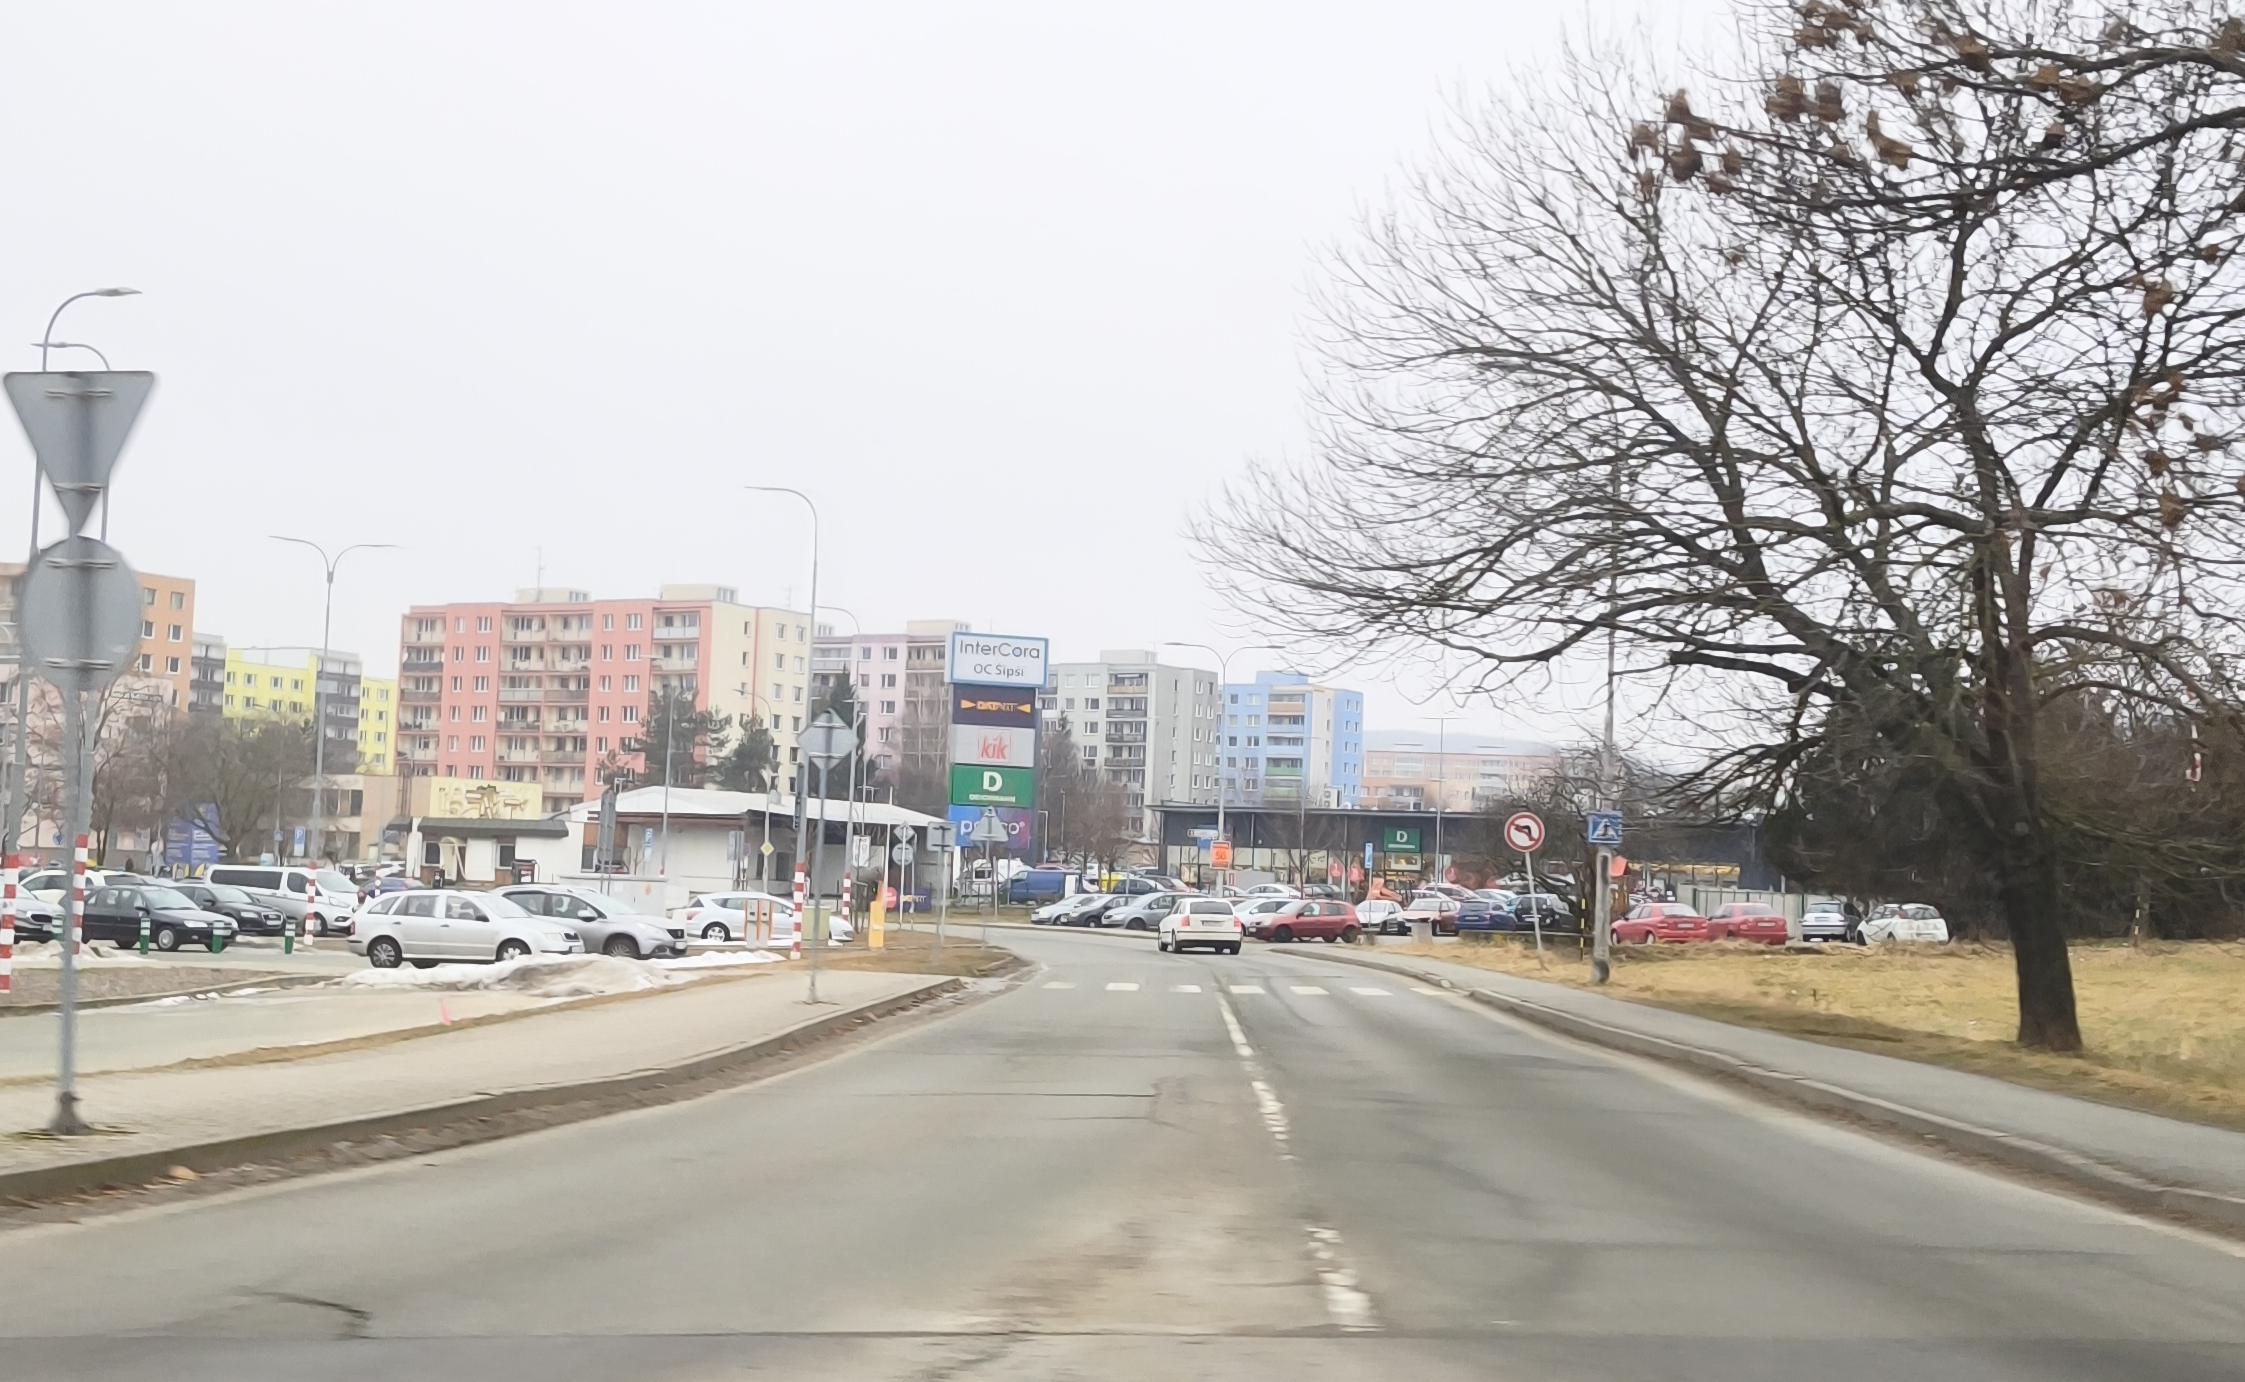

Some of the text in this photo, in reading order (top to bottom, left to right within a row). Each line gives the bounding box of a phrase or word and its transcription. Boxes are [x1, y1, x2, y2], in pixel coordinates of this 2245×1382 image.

[960, 640, 1040, 659] InterCora
[973, 663, 992, 674] OC
[983, 771, 1002, 792] D
[1396, 830, 1408, 842] D
